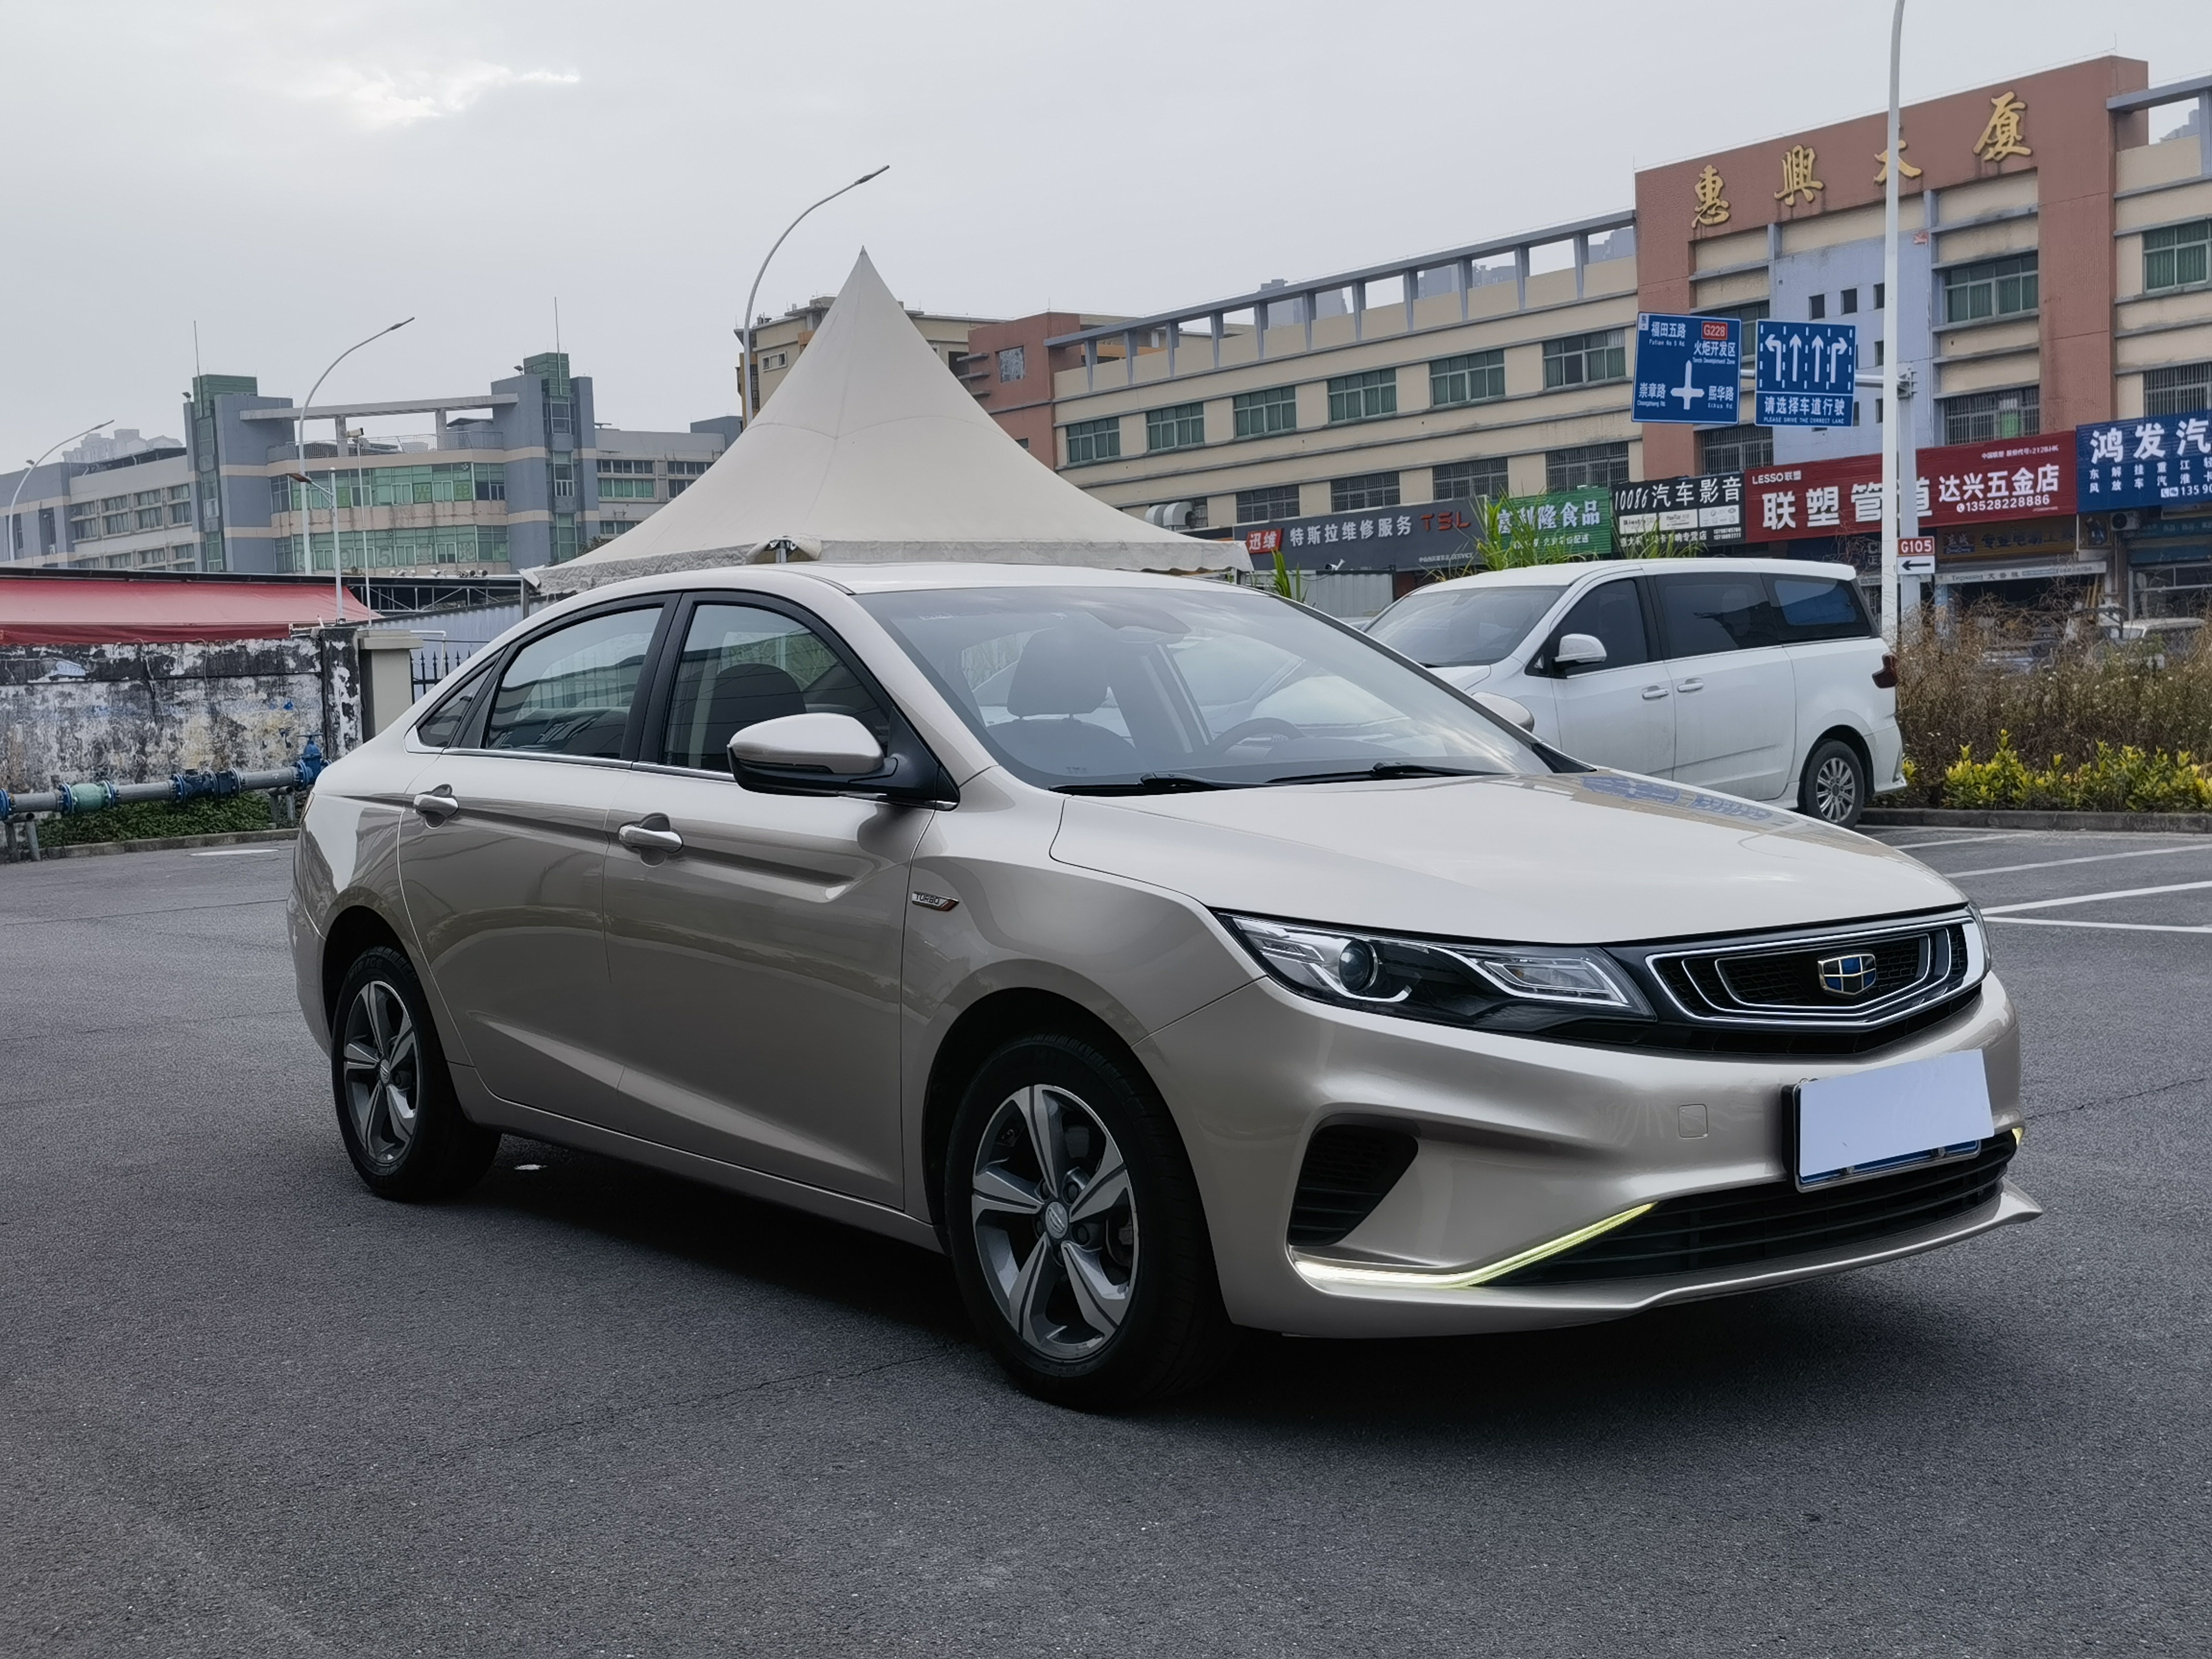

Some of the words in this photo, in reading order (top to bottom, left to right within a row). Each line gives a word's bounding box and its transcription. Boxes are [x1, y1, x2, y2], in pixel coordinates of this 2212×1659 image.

[1651, 321, 1686, 339] 福田五路
[1704, 325, 1726, 337] G228
[1694, 340, 1736, 357] 火炬开发区
[1764, 396, 1845, 416] 请选择车道行驶
[2090, 418, 2211, 464] 鸿发汽
[1752, 473, 1783, 484] LESSO
[2089, 468, 2100, 493] 东风
[2111, 466, 2121, 491] 解放
[2157, 462, 2167, 487] 重汽
[2180, 460, 2190, 484] 江淮
[1939, 463, 2059, 502] 达兴五金店
[2181, 485, 2199, 496] 135
[1966, 494, 2050, 512] 13528228886
[1290, 515, 1412, 547] 特斯拉维修服务
[1249, 532, 1277, 550] 迅维
[1901, 539, 1932, 553] G105
[915, 893, 940, 905] TURBO
